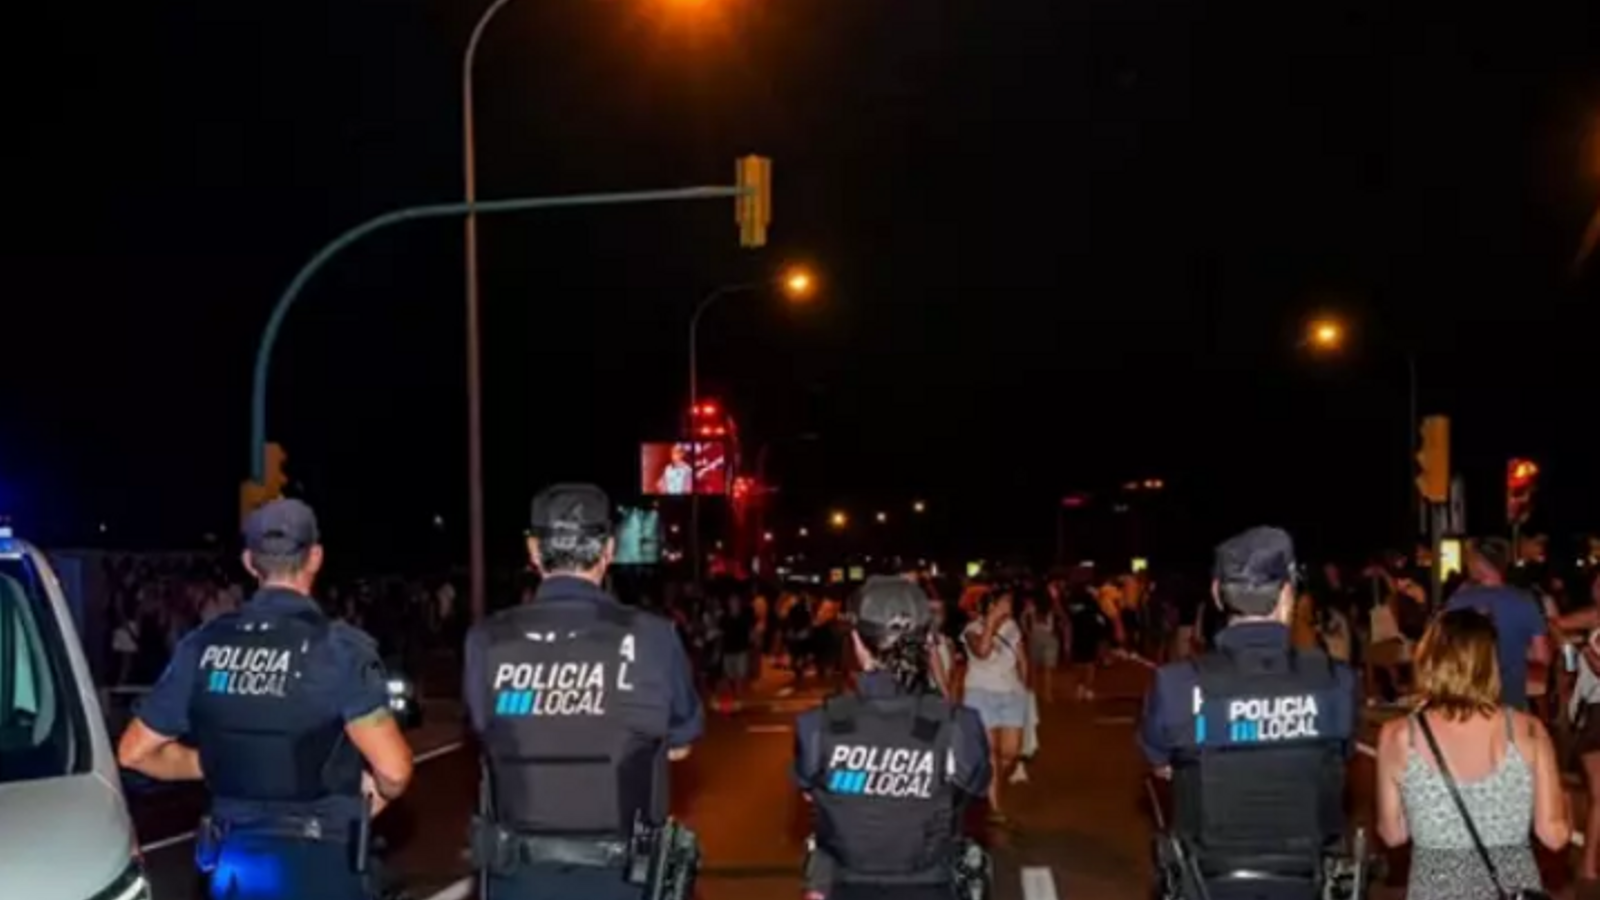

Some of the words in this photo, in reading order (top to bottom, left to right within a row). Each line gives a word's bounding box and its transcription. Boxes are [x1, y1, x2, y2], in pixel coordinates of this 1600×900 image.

[200, 645, 291, 672] POLICIA
[227, 671, 286, 697] LOCAL
[494, 663, 604, 690] POLICIA
[532, 691, 605, 715] LOCAL
[1230, 695, 1318, 720] POLICIA
[1258, 717, 1319, 740] LOCAL
[829, 745, 933, 774] POLICIA
[864, 771, 932, 798] LOCAL
